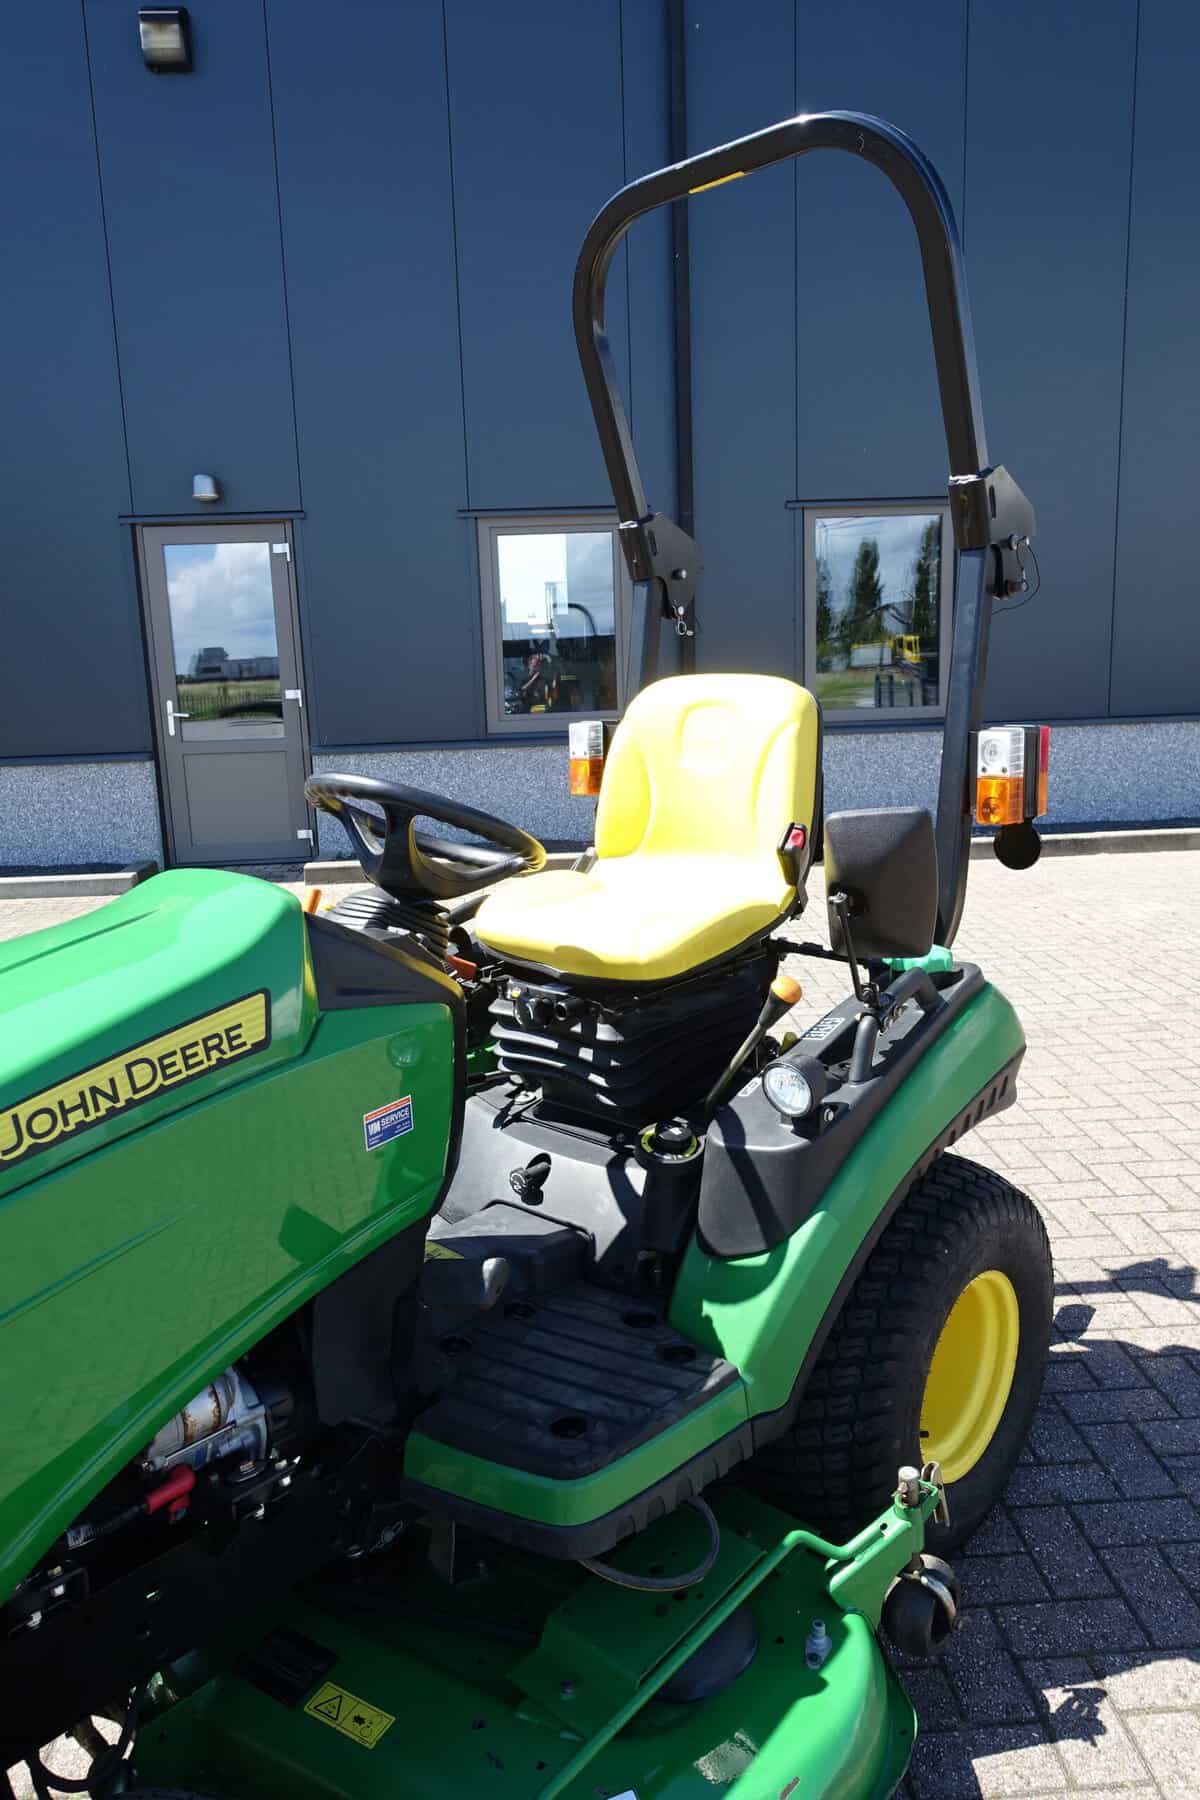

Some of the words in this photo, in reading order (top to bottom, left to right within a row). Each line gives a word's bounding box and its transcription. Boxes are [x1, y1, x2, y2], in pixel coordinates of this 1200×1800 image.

[0, 1076, 121, 1157] JOHN
[125, 1023, 248, 1096] DEERE
[381, 1107, 410, 1127] SERVICE
